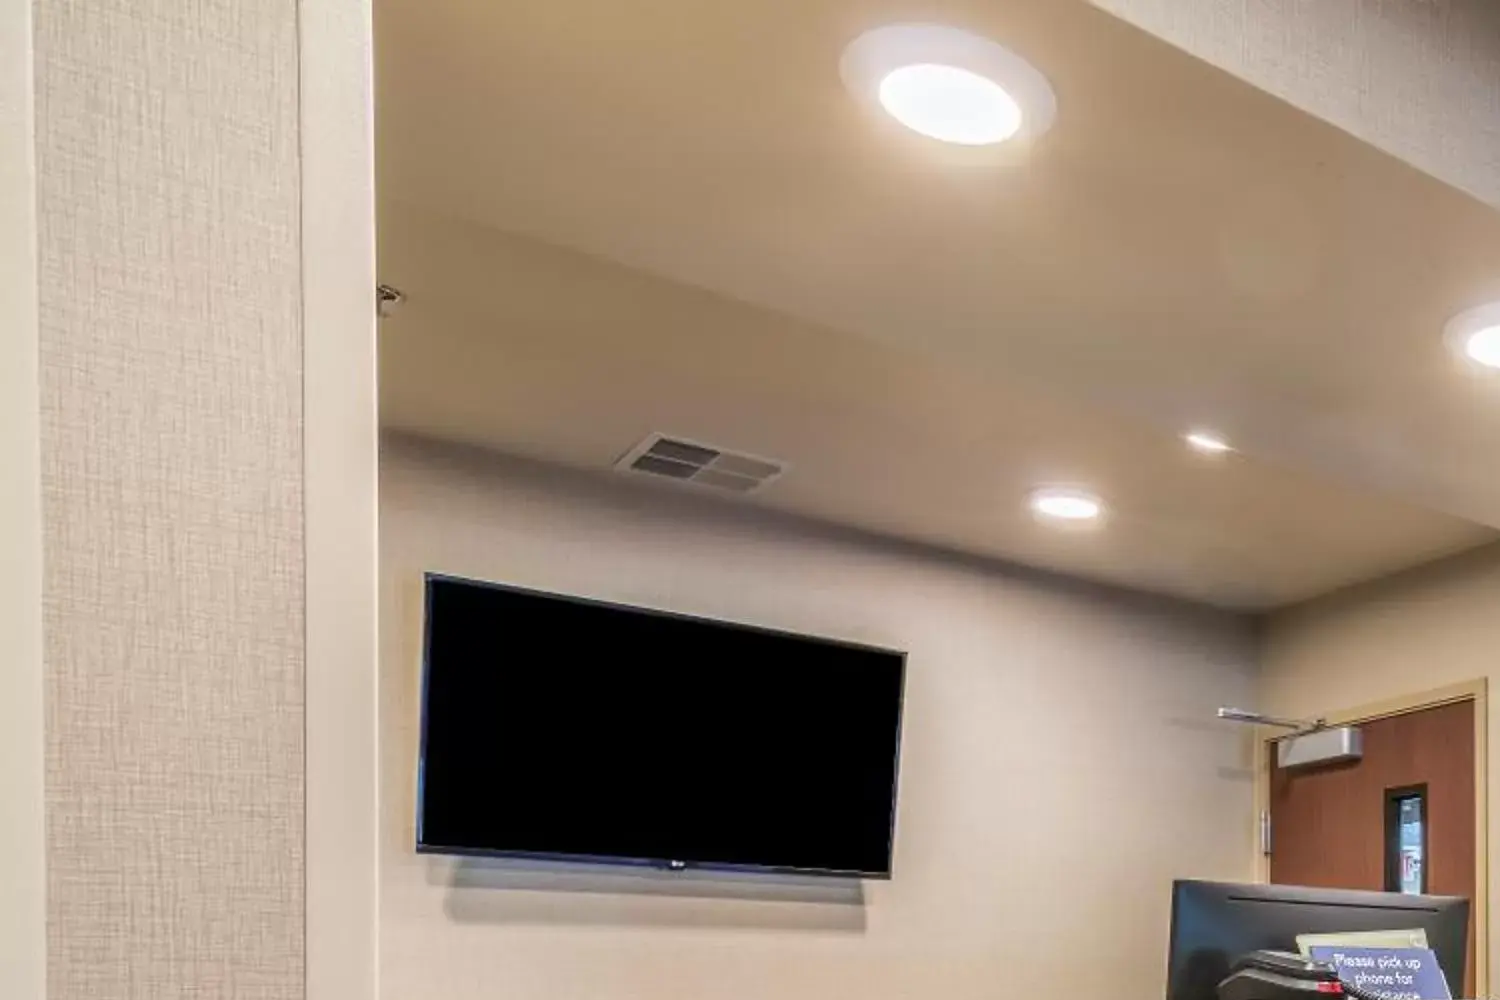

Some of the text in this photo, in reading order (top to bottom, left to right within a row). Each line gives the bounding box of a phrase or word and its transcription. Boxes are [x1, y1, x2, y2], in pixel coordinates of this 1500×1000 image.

[1333, 953, 1421, 972] Please pick up
[1355, 971, 1413, 988] phone for
